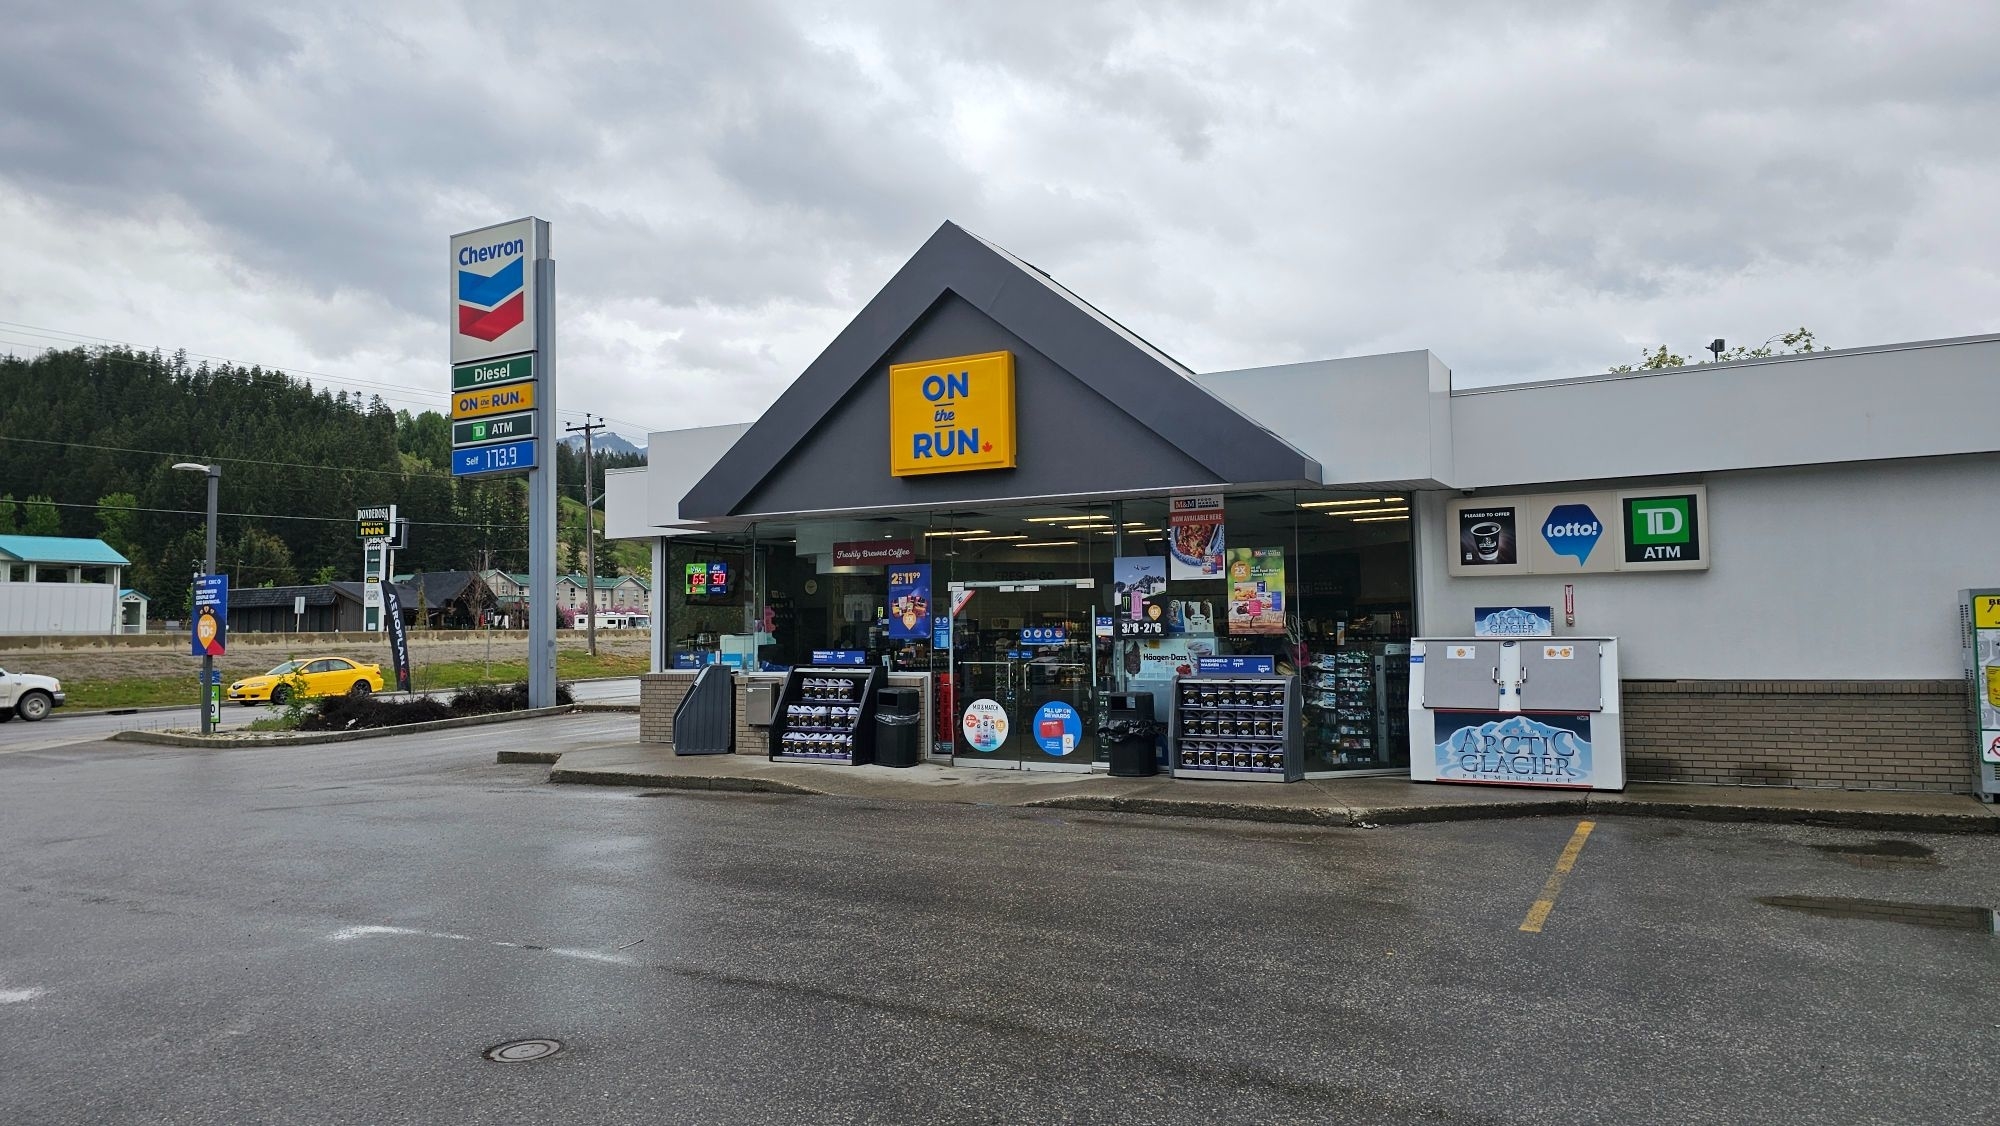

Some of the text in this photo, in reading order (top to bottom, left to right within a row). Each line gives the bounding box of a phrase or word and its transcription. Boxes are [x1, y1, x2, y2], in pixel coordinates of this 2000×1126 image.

[459, 239, 523, 266] Chevron
[475, 363, 510, 382] Diesel
[922, 371, 969, 402] ON
[460, 391, 519, 412] ON the RUN
[934, 409, 955, 422] the
[474, 421, 513, 437] TD ATM
[913, 427, 979, 459] RUN
[466, 446, 517, 468] Self 173.9
[357, 508, 389, 521] PONDEROSA
[1184, 514, 1209, 522] AVAILABLE
[1637, 507, 1683, 535] TD
[361, 527, 384, 535] INN
[1547, 521, 1598, 538] lotto!
[836, 547, 910, 560] Freshly Brewed Coffee
[1644, 545, 1681, 559] ATM
[692, 573, 726, 585] 65 50
[1489, 613, 1536, 625] ARCTIC
[389, 593, 405, 666] AEROPLAN
[1490, 624, 1534, 634] GLACIER
[1458, 728, 1575, 757] ARCTIC
[1460, 754, 1576, 777] GLACIER
[1462, 773, 1534, 782] PREMIUM
